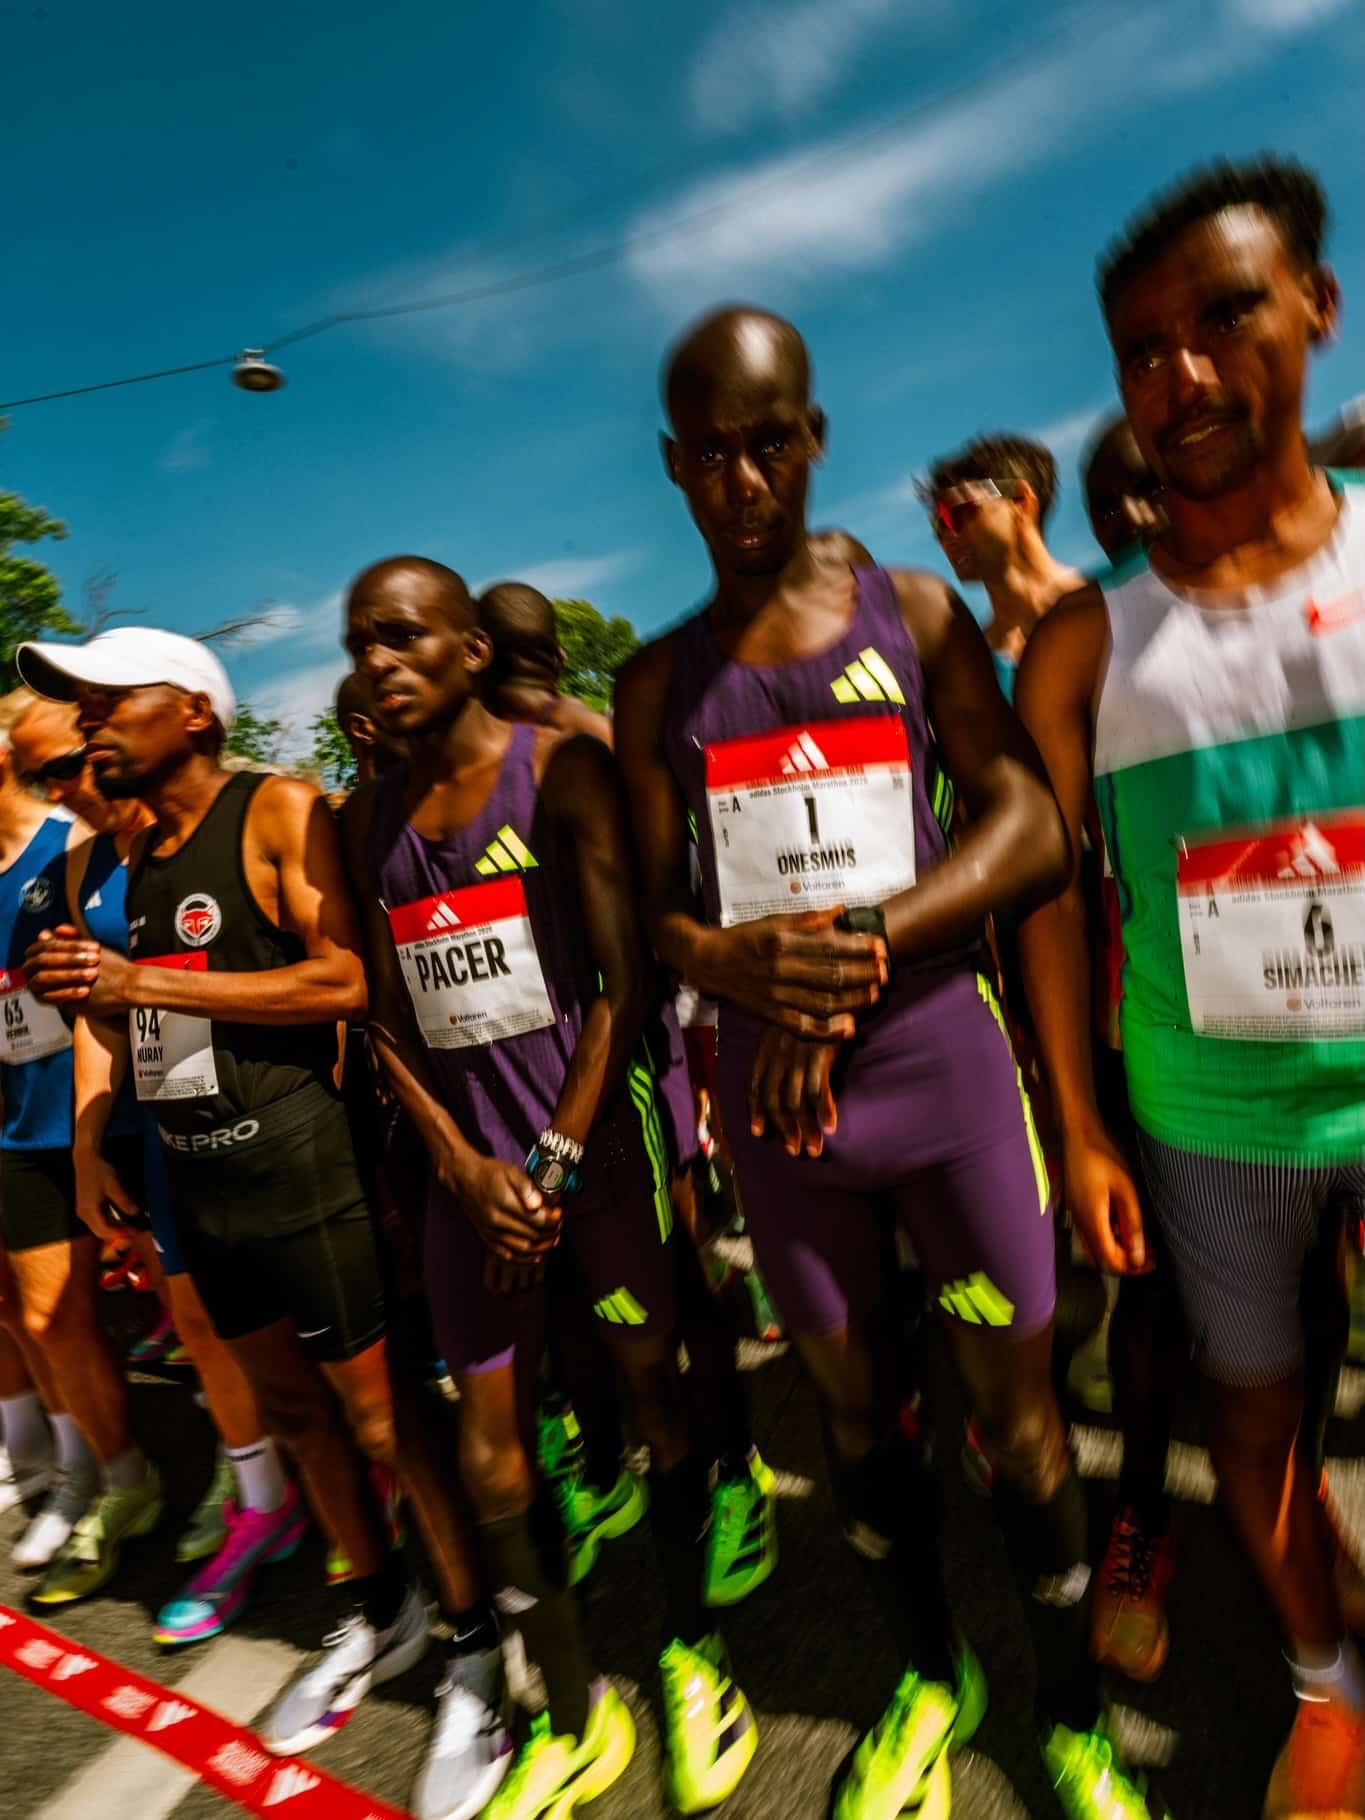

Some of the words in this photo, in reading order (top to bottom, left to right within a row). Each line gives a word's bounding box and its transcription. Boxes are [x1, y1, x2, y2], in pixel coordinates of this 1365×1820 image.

[732, 796, 742, 814] A
[804, 795, 820, 844] 1
[777, 848, 857, 875] ONESMUS
[802, 879, 846, 893] Voltaren
[1208, 898, 1219, 918] A
[1303, 900, 1335, 957] 6
[414, 937, 512, 992] PACER
[1262, 958, 1365, 990] SIMACHE
[5, 998, 23, 1026] 63
[1304, 996, 1361, 1010] Voltaren
[136, 1007, 160, 1042] 94
[191, 1119, 260, 1153] PRO
